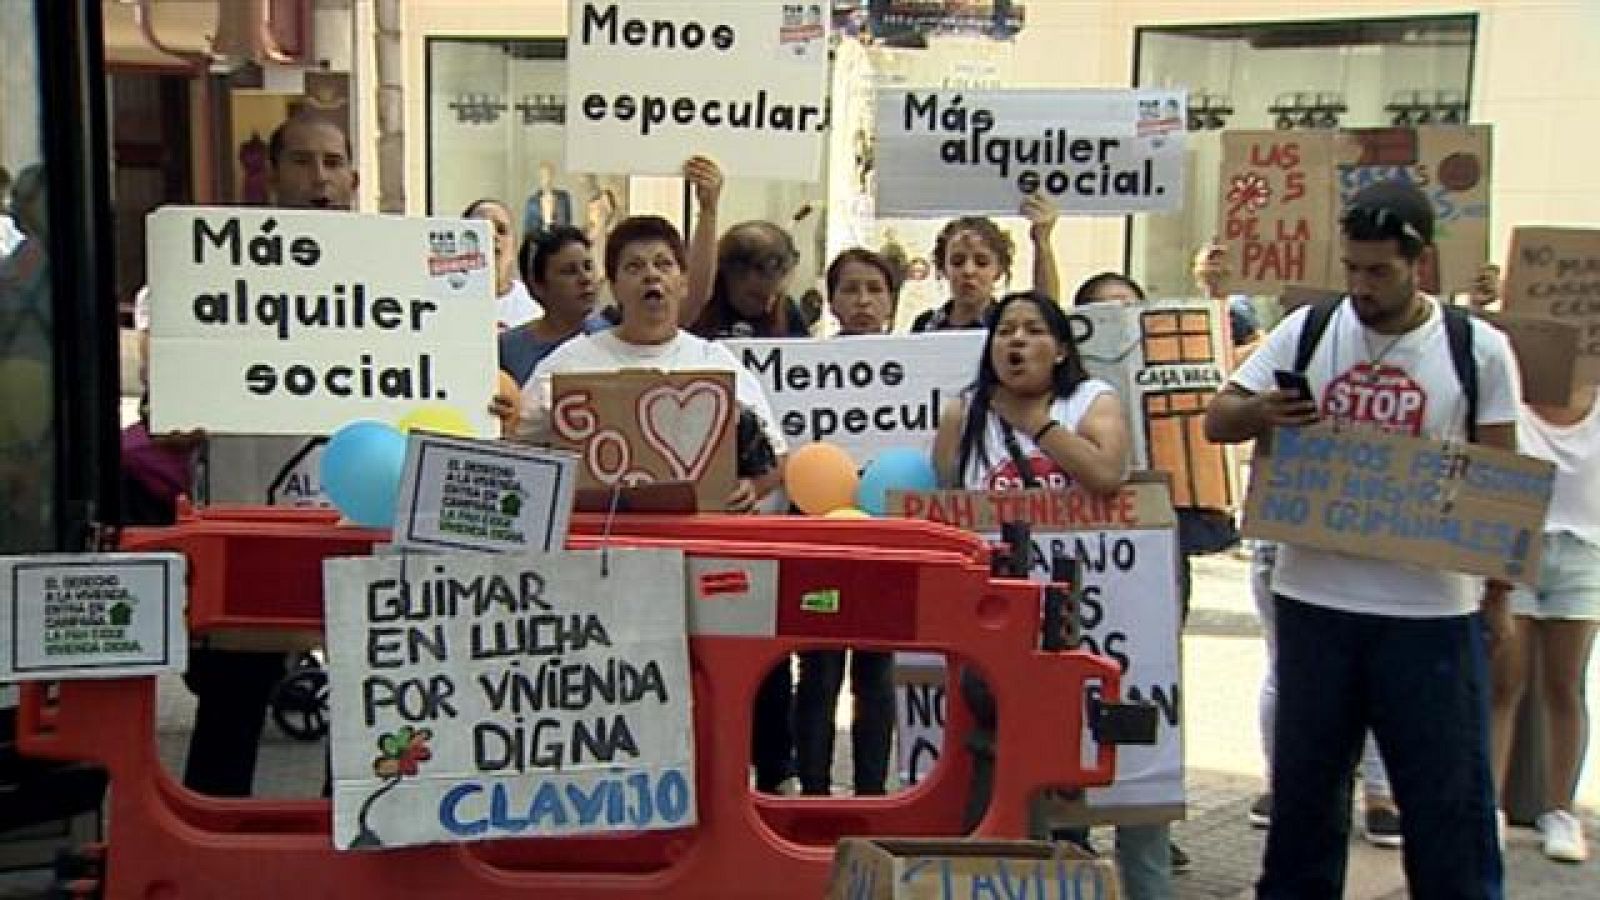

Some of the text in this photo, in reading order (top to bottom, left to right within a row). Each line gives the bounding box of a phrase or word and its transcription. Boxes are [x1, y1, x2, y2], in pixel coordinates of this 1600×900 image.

[583, 4, 734, 49] Menos
[583, 90, 824, 135] especular.
[904, 93, 995, 132] Más
[940, 128, 1120, 177] alquiler
[1252, 143, 1301, 170] LAS
[1017, 159, 1165, 196] social.
[193, 217, 321, 266] Más
[1226, 217, 1311, 241] DE LA
[1241, 243, 1306, 281] PAH
[193, 279, 438, 340] alquiler
[245, 354, 448, 398] social.
[742, 347, 904, 393] Menos
[782, 388, 941, 440] specul
[1326, 383, 1424, 422] STOP
[903, 489, 1136, 527] PAH TENERIFE
[368, 566, 552, 623] GUIMAR
[368, 614, 612, 668] EN LUCHA
[363, 657, 668, 727] POR VIVIENDA
[474, 714, 640, 773] DIGNA
[439, 769, 689, 835] CLAVIJO
